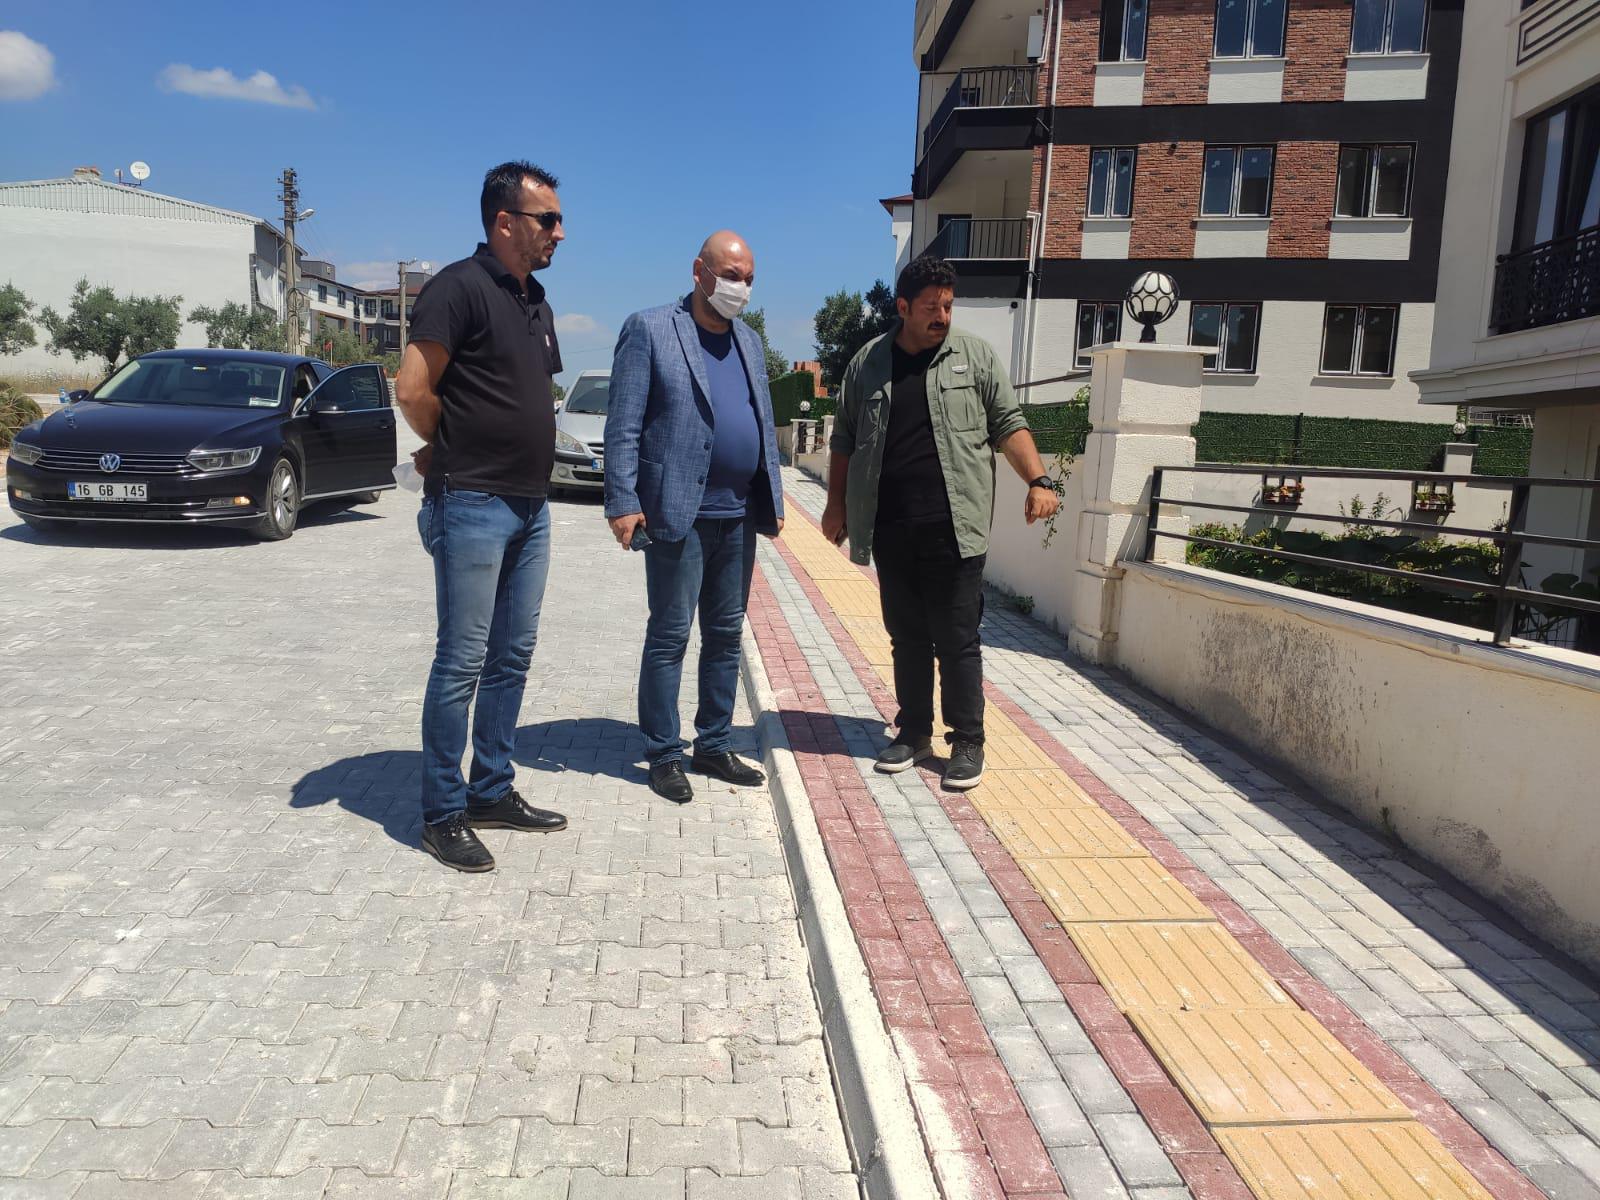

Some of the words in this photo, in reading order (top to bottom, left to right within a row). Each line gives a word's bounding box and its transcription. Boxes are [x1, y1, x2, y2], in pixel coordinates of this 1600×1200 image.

[78, 485, 90, 496] 16
[98, 485, 114, 497] GB
[124, 485, 145, 497] 145
